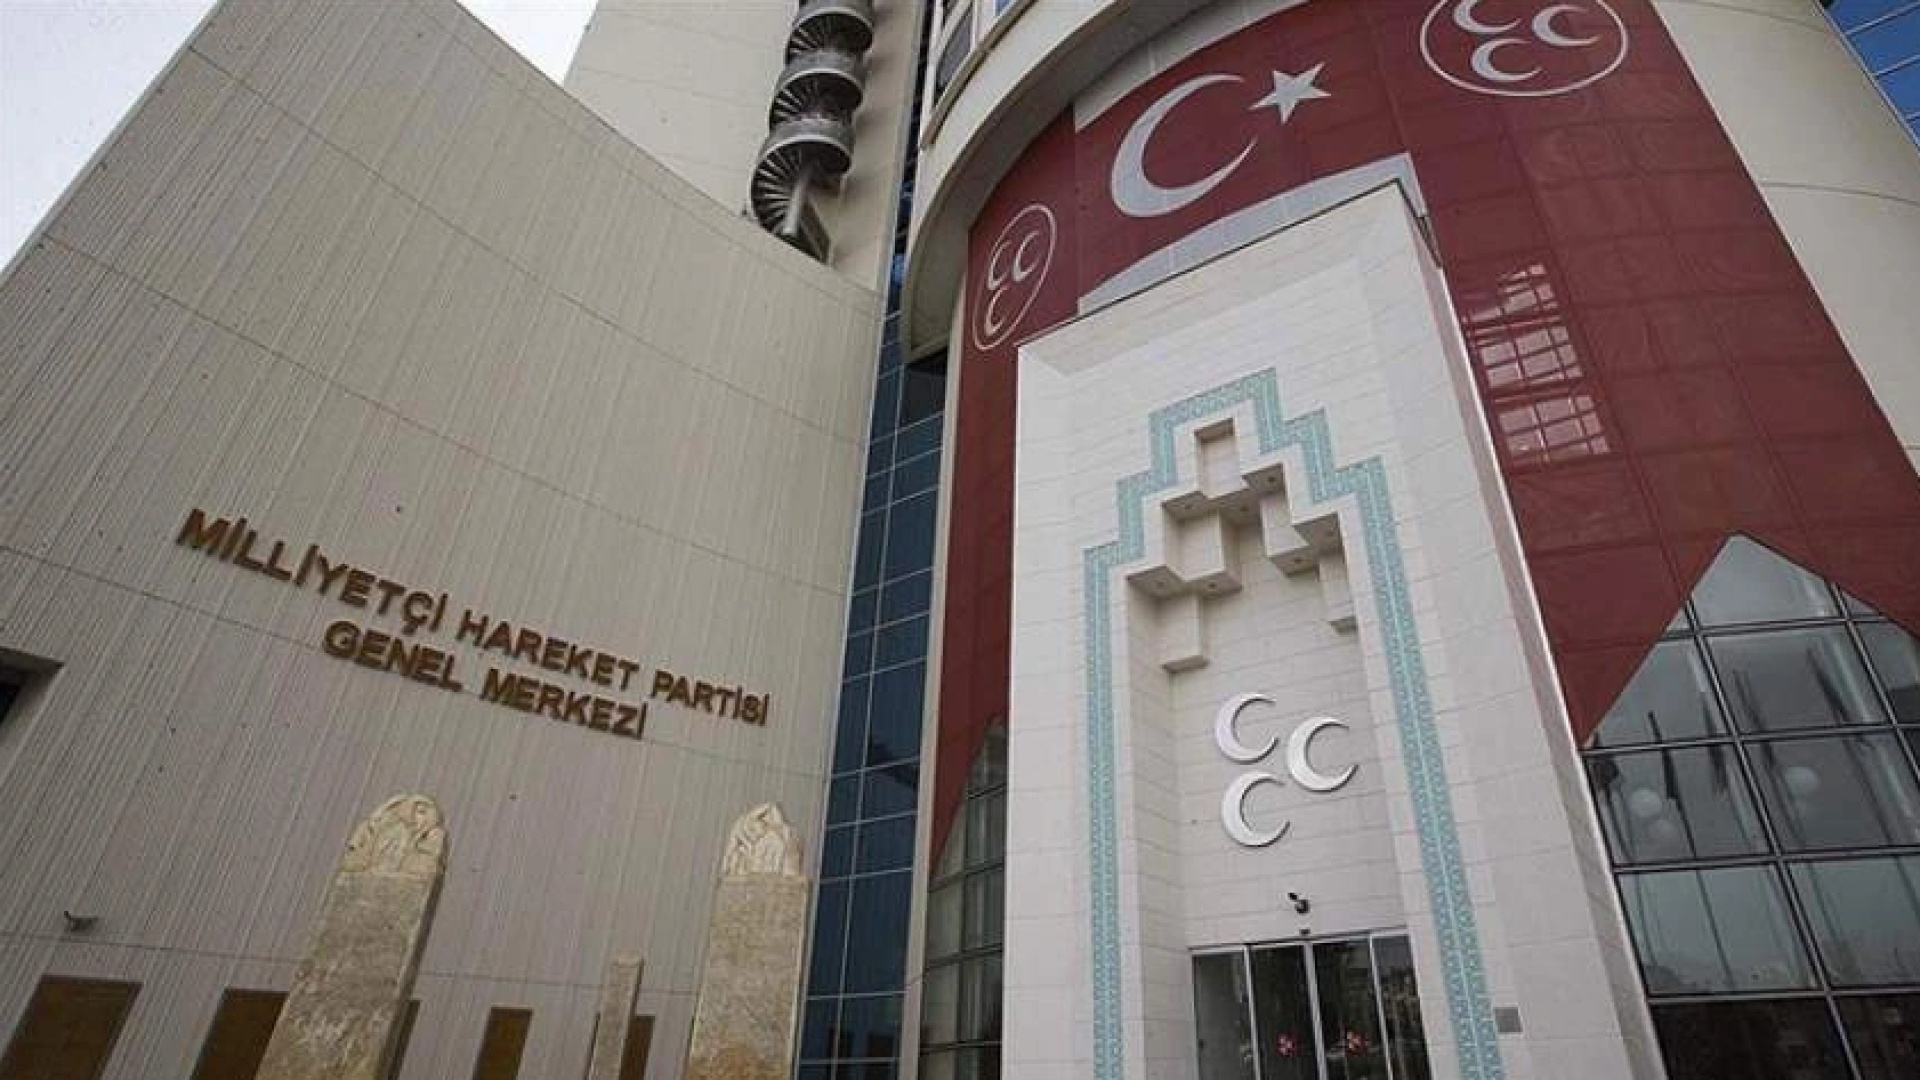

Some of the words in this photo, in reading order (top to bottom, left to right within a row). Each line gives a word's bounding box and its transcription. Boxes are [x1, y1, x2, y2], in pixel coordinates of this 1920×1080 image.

[176, 508, 448, 635] MİLLİYETÇİ
[457, 609, 640, 691] HAREKET
[651, 670, 770, 726] PARTİSİ
[323, 620, 463, 692] GENEL
[479, 668, 647, 740] MERKEZİ
